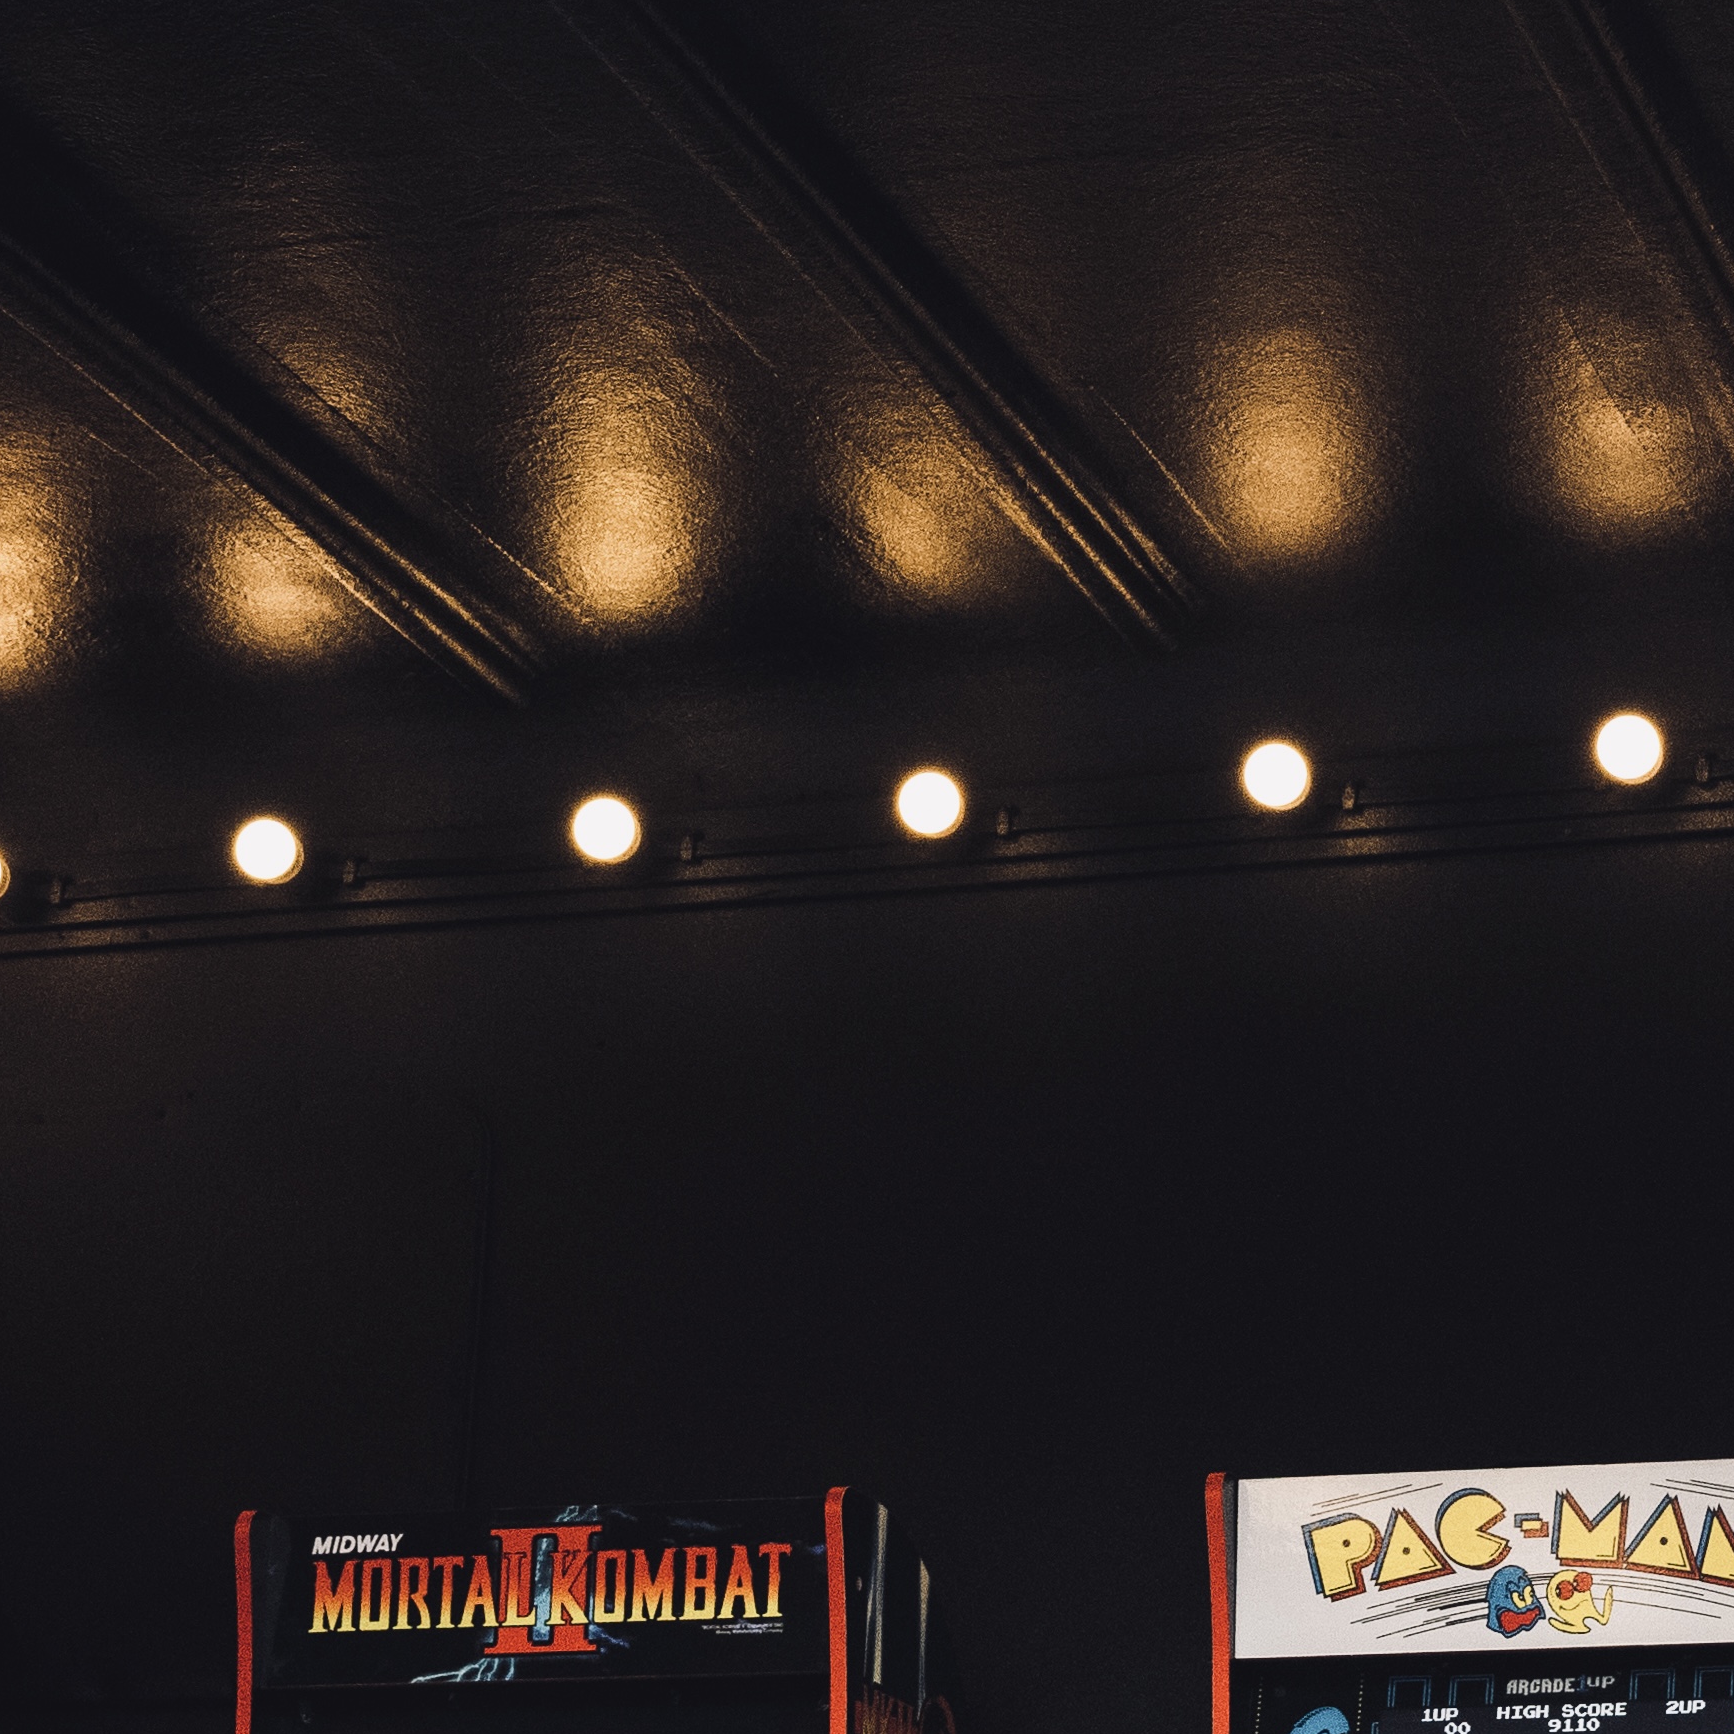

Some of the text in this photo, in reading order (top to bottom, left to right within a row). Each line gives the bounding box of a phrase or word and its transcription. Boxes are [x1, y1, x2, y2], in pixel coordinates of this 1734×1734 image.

[311, 1533, 404, 1556] MIDWAY
[307, 1543, 793, 1634] MORTAL KOMBAT
[1421, 1699, 1707, 1722] 1UP HIGH SCORE 2UP
[1546, 1717, 1601, 1734] 9110
